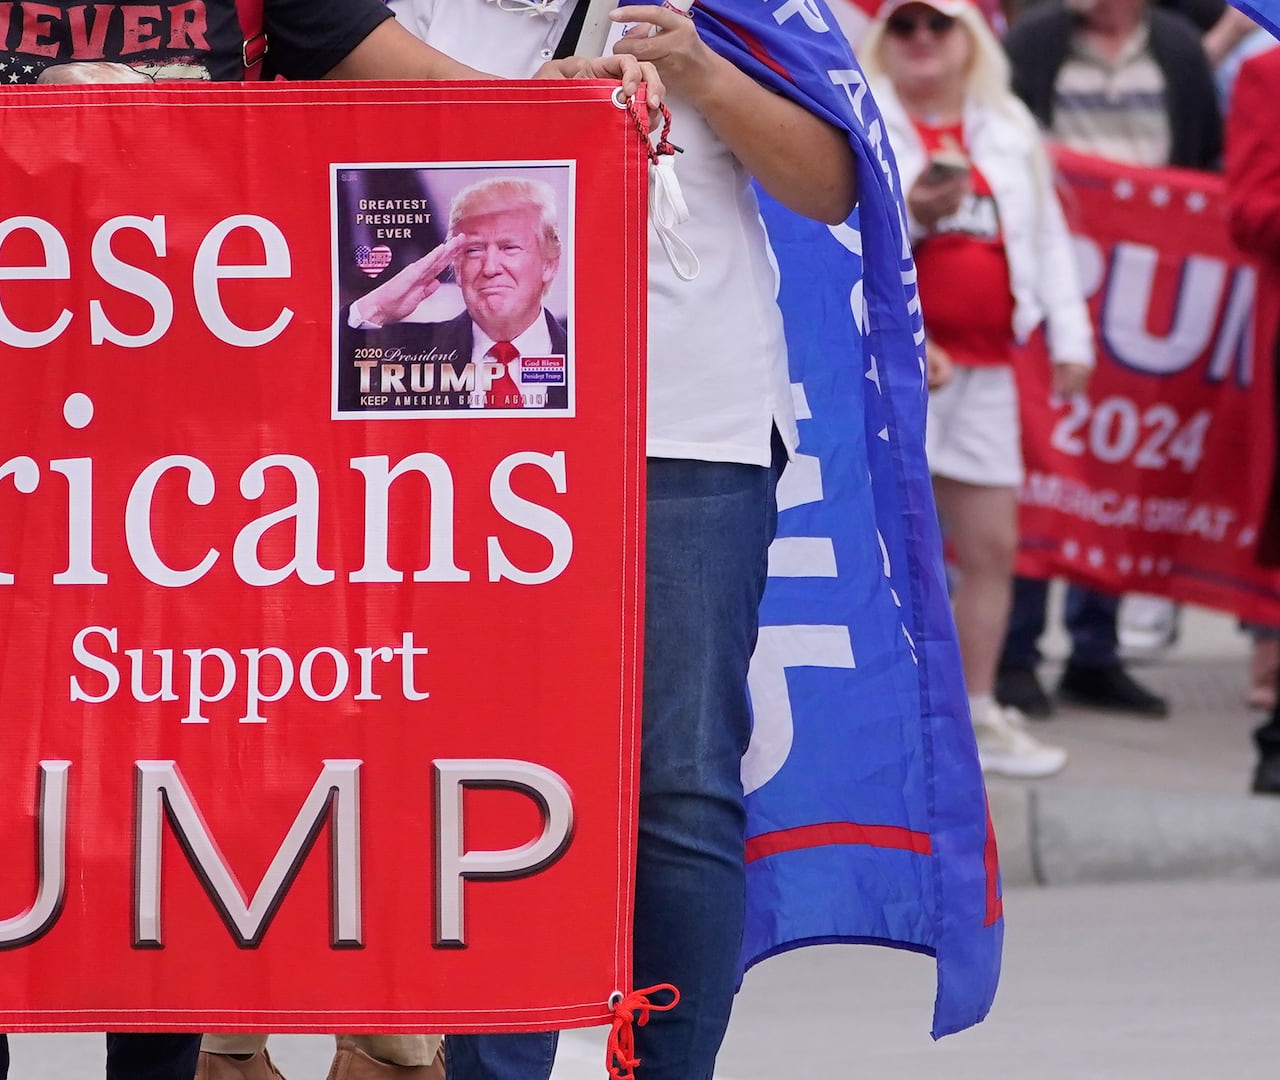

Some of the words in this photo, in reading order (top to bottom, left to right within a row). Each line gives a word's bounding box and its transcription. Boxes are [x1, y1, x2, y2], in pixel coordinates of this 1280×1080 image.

[359, 199, 428, 210] GREATEST
[356, 213, 431, 224] PRESIDENT
[376, 228, 412, 239] EVER
[354, 348, 383, 359] 2020
[382, 346, 458, 362] President
[524, 359, 540, 367] God
[354, 360, 505, 393] TRUMP
[360, 395, 388, 406] KEEP
[395, 395, 450, 406] AMERICA
[1050, 392, 1213, 473] 2024
[69, 625, 430, 726] Support
